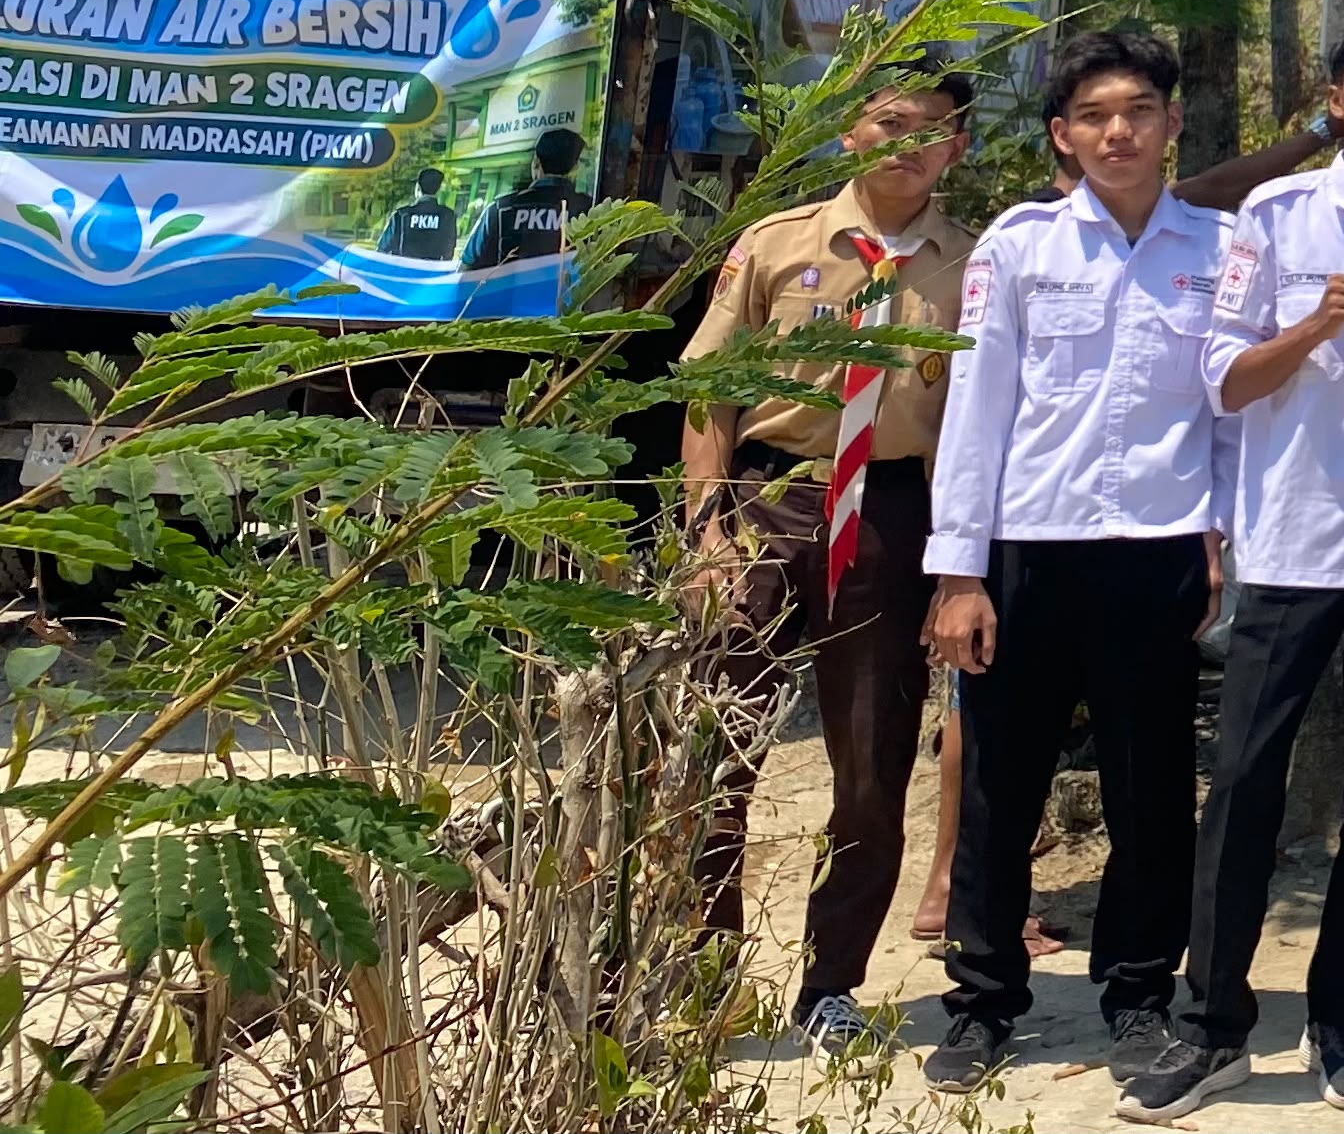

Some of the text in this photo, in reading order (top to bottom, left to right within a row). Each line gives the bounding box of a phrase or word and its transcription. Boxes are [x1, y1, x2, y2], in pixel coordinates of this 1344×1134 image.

[81, 64, 120, 101] DI
[128, 68, 218, 106] MAN
[229, 73, 254, 105] 2
[264, 72, 411, 114] SRAGEN
[490, 110, 575, 136] MAN 2 SRAGEN
[140, 124, 295, 157] MADRASAH
[301, 130, 374, 164] (PKM)
[410, 214, 440, 230] PKM
